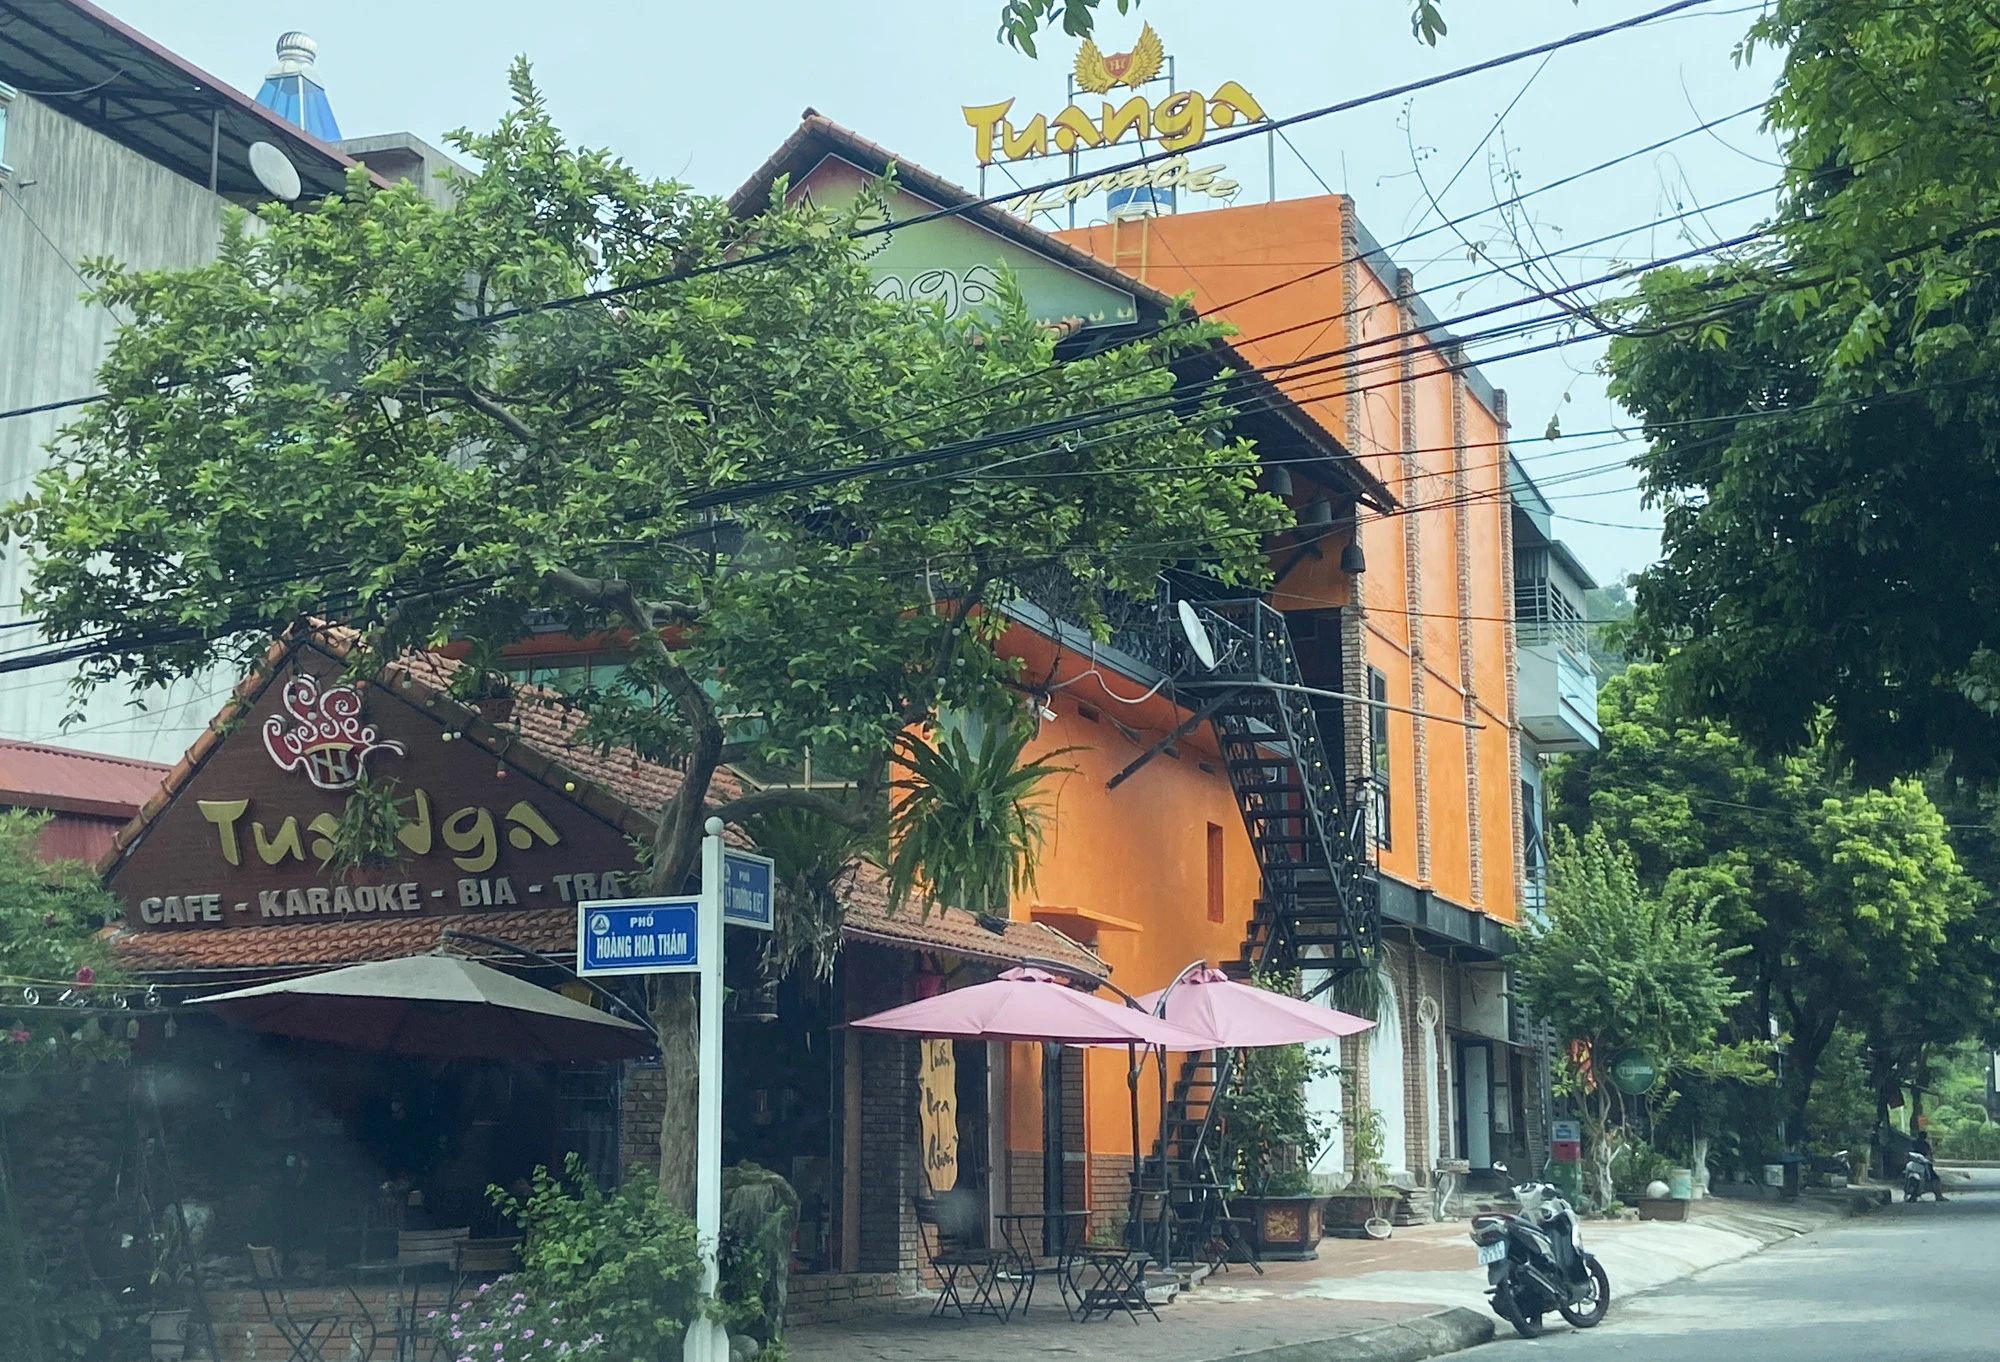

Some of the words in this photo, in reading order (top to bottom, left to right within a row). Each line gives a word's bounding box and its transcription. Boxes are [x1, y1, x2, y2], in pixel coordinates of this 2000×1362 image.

[139, 894, 223, 925] CAFE
[258, 882, 421, 918] KARAOKE
[457, 876, 518, 908] BIA
[629, 911, 655, 929] PHỐ
[596, 931, 632, 959] HOÀNG
[634, 933, 656, 957] HOA
[657, 928, 687, 956] THÁM
